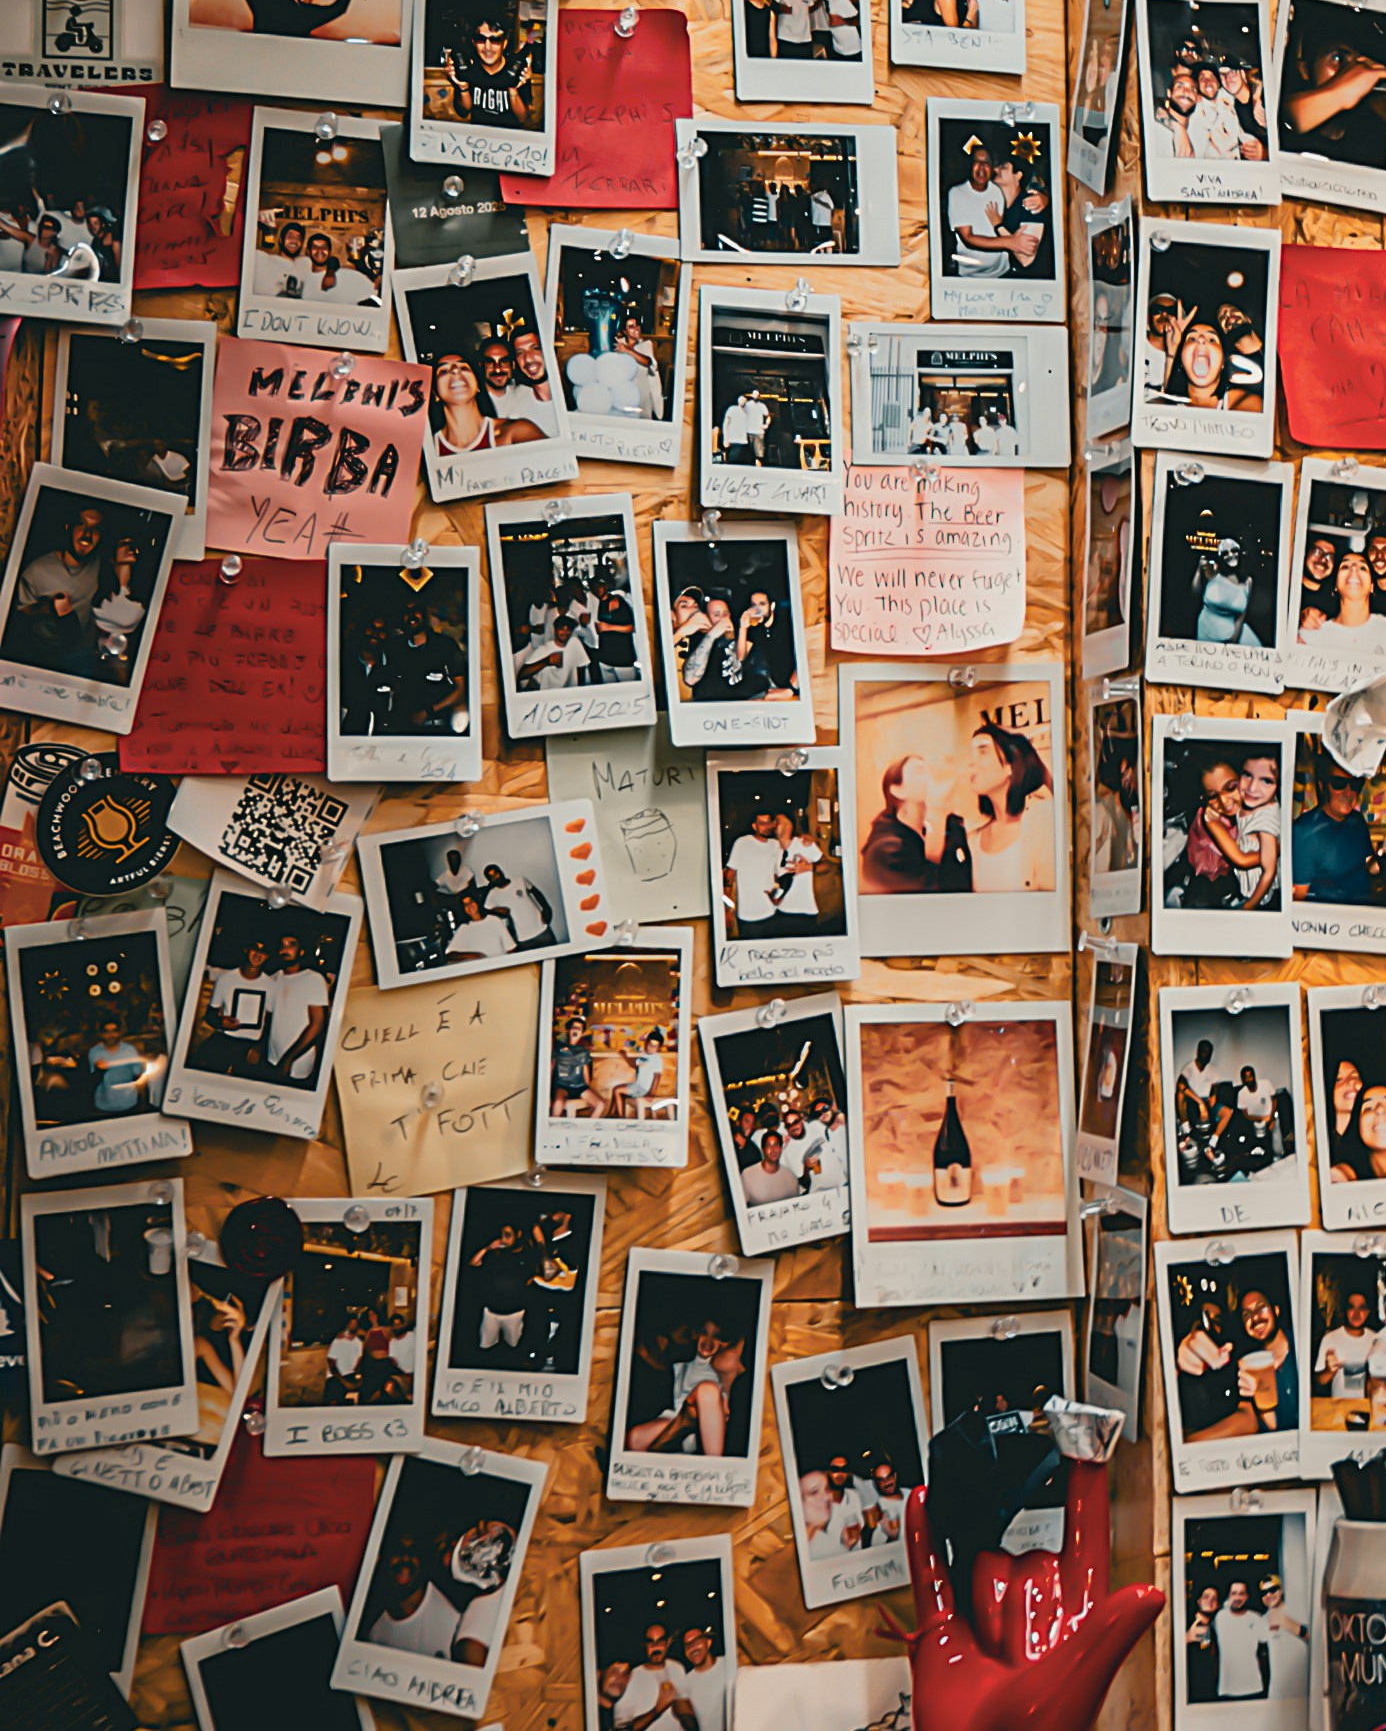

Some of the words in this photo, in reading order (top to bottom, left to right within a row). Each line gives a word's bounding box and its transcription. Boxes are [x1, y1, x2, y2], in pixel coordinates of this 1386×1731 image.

[1, 61, 154, 82] TRAVELERS
[412, 207, 427, 219] 12
[429, 205, 475, 219] Agosto
[842, 460, 873, 490] You
[879, 473, 910, 492] are
[915, 474, 981, 506] making
[913, 500, 953, 522] The
[963, 504, 1005, 525] Beer
[904, 528, 925, 546] is
[837, 563, 864, 588] We
[873, 568, 907, 589] will
[914, 569, 962, 590] never
[919, 595, 966, 622] place
[975, 596, 991, 612] is
[936, 621, 996, 646] Alyssa
[350, 1069, 417, 1095] PRIMA
